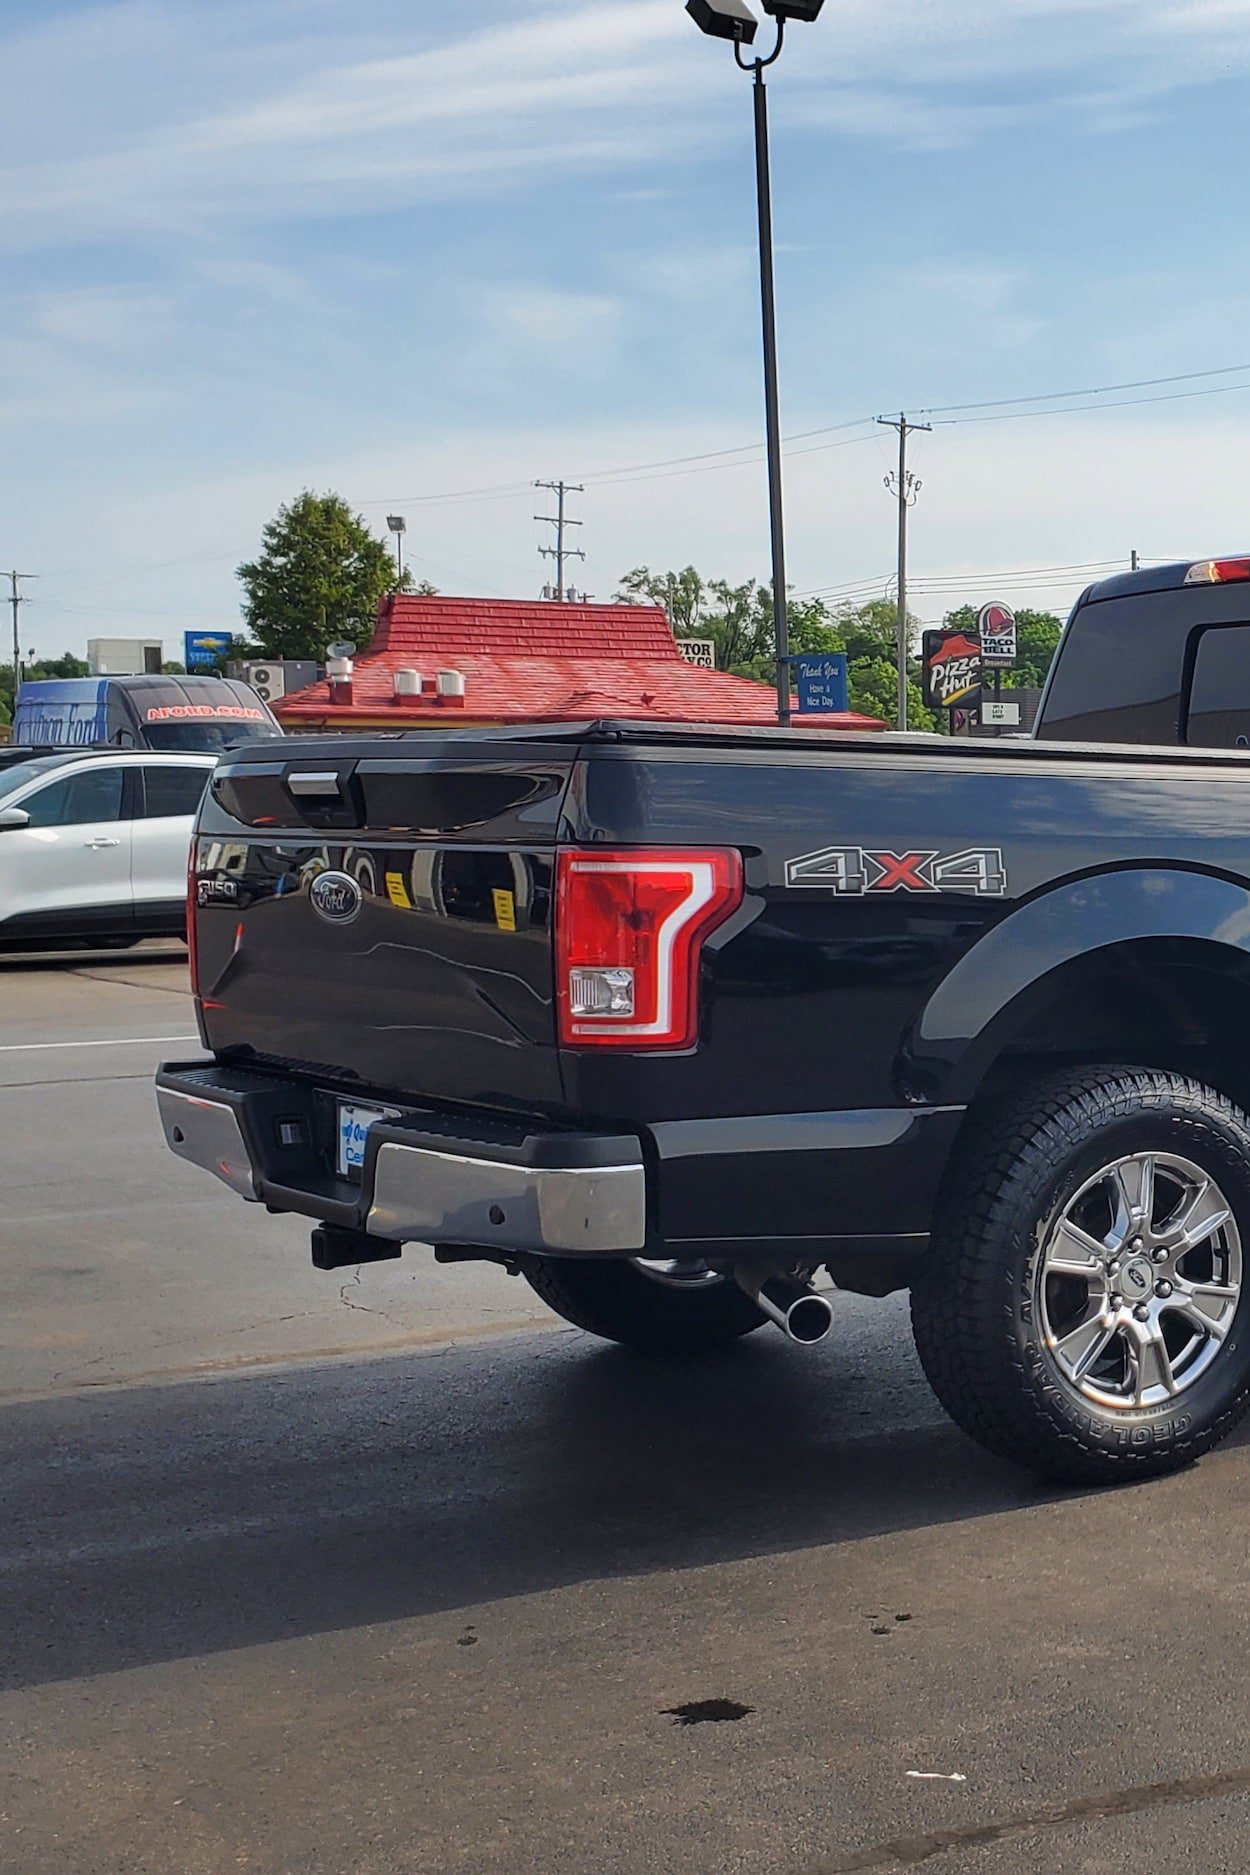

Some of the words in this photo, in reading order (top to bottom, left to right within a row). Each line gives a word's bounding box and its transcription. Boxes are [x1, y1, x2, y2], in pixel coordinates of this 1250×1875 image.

[982, 638, 1013, 646] TACO
[983, 647, 1014, 655] BELL
[800, 662, 822, 679] Thank
[823, 661, 839, 680] You
[930, 656, 981, 693] Pizza
[809, 684, 825, 693] Have
[940, 670, 977, 698] Hut
[807, 697, 820, 706] Nice
[147, 705, 265, 720] AFORD.COM
[315, 881, 347, 911] Ford
